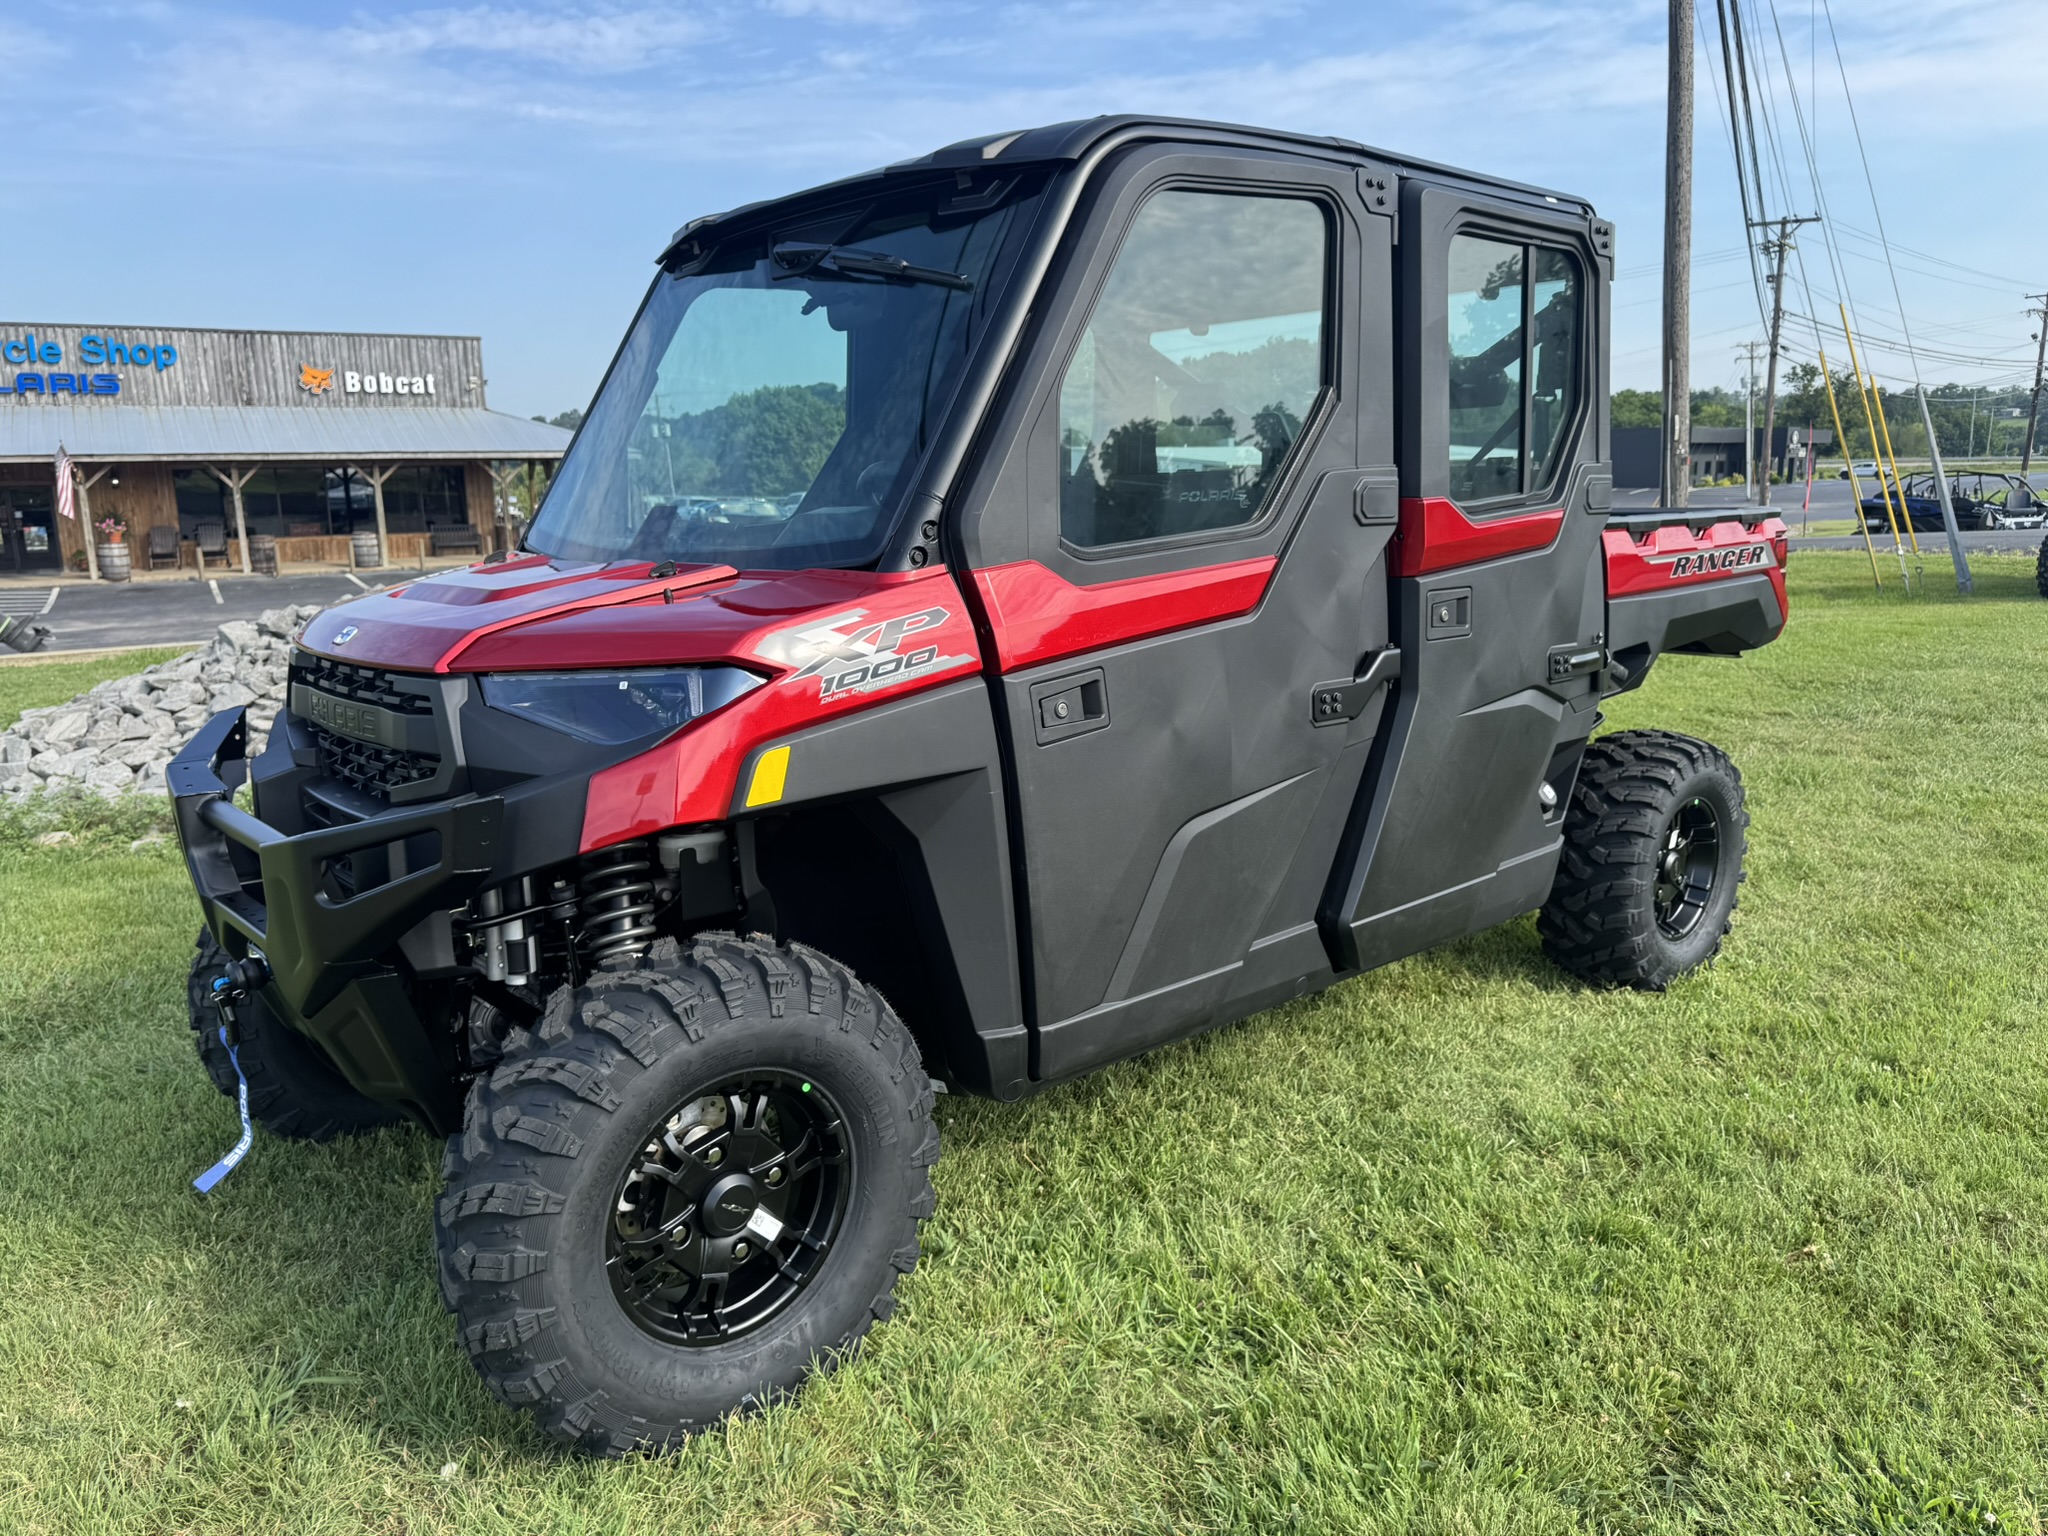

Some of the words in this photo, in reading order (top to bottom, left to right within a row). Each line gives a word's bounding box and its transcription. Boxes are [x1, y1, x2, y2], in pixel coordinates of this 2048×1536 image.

[0, 334, 62, 364] cle
[81, 335, 178, 371] Shop
[344, 371, 436, 394] Bobcat
[1179, 487, 1247, 503] POLARIS
[1670, 545, 1765, 578] RANGER
[778, 606, 950, 686] XP
[819, 645, 938, 698] 1000
[819, 690, 850, 705] DUAL
[851, 672, 908, 695] OVERHEAD
[911, 665, 934, 676] CAM
[804, 1037, 898, 1147] X-TERRAIN
[222, 1083, 251, 1168] POLARIS
